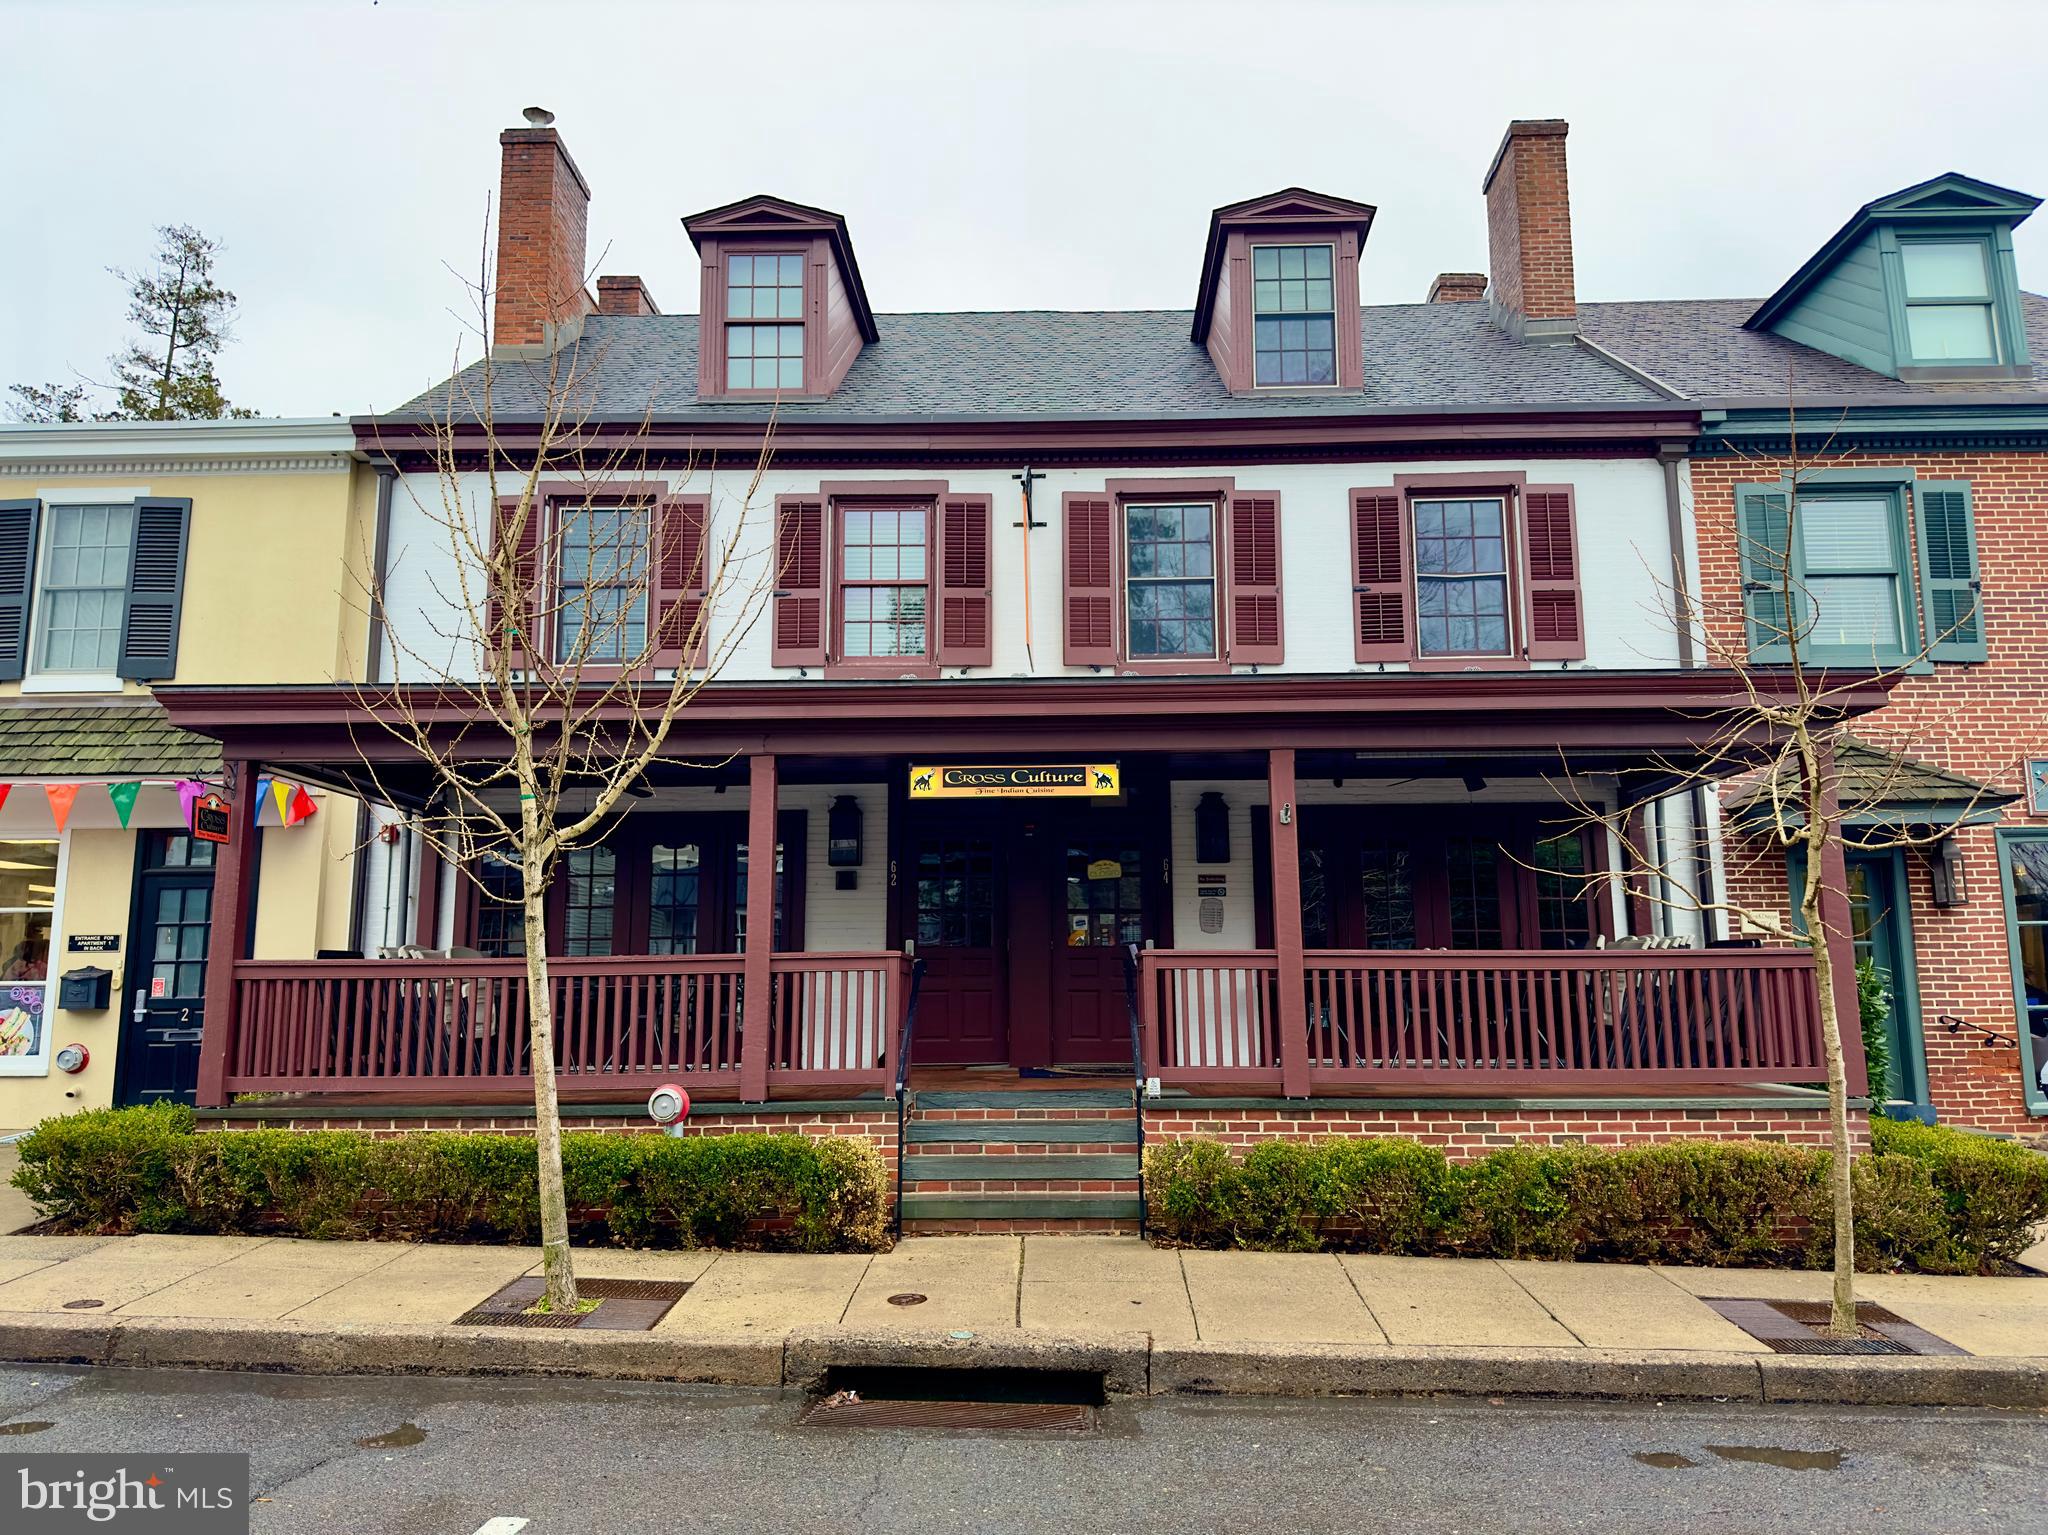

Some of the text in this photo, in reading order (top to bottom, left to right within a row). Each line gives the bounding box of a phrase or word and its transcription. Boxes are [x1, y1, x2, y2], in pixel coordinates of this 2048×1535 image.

[1011, 769, 1084, 784] Culture
[890, 860, 898, 886] 62
[1162, 857, 1169, 885] 64
[180, 1007, 189, 1022] 2
